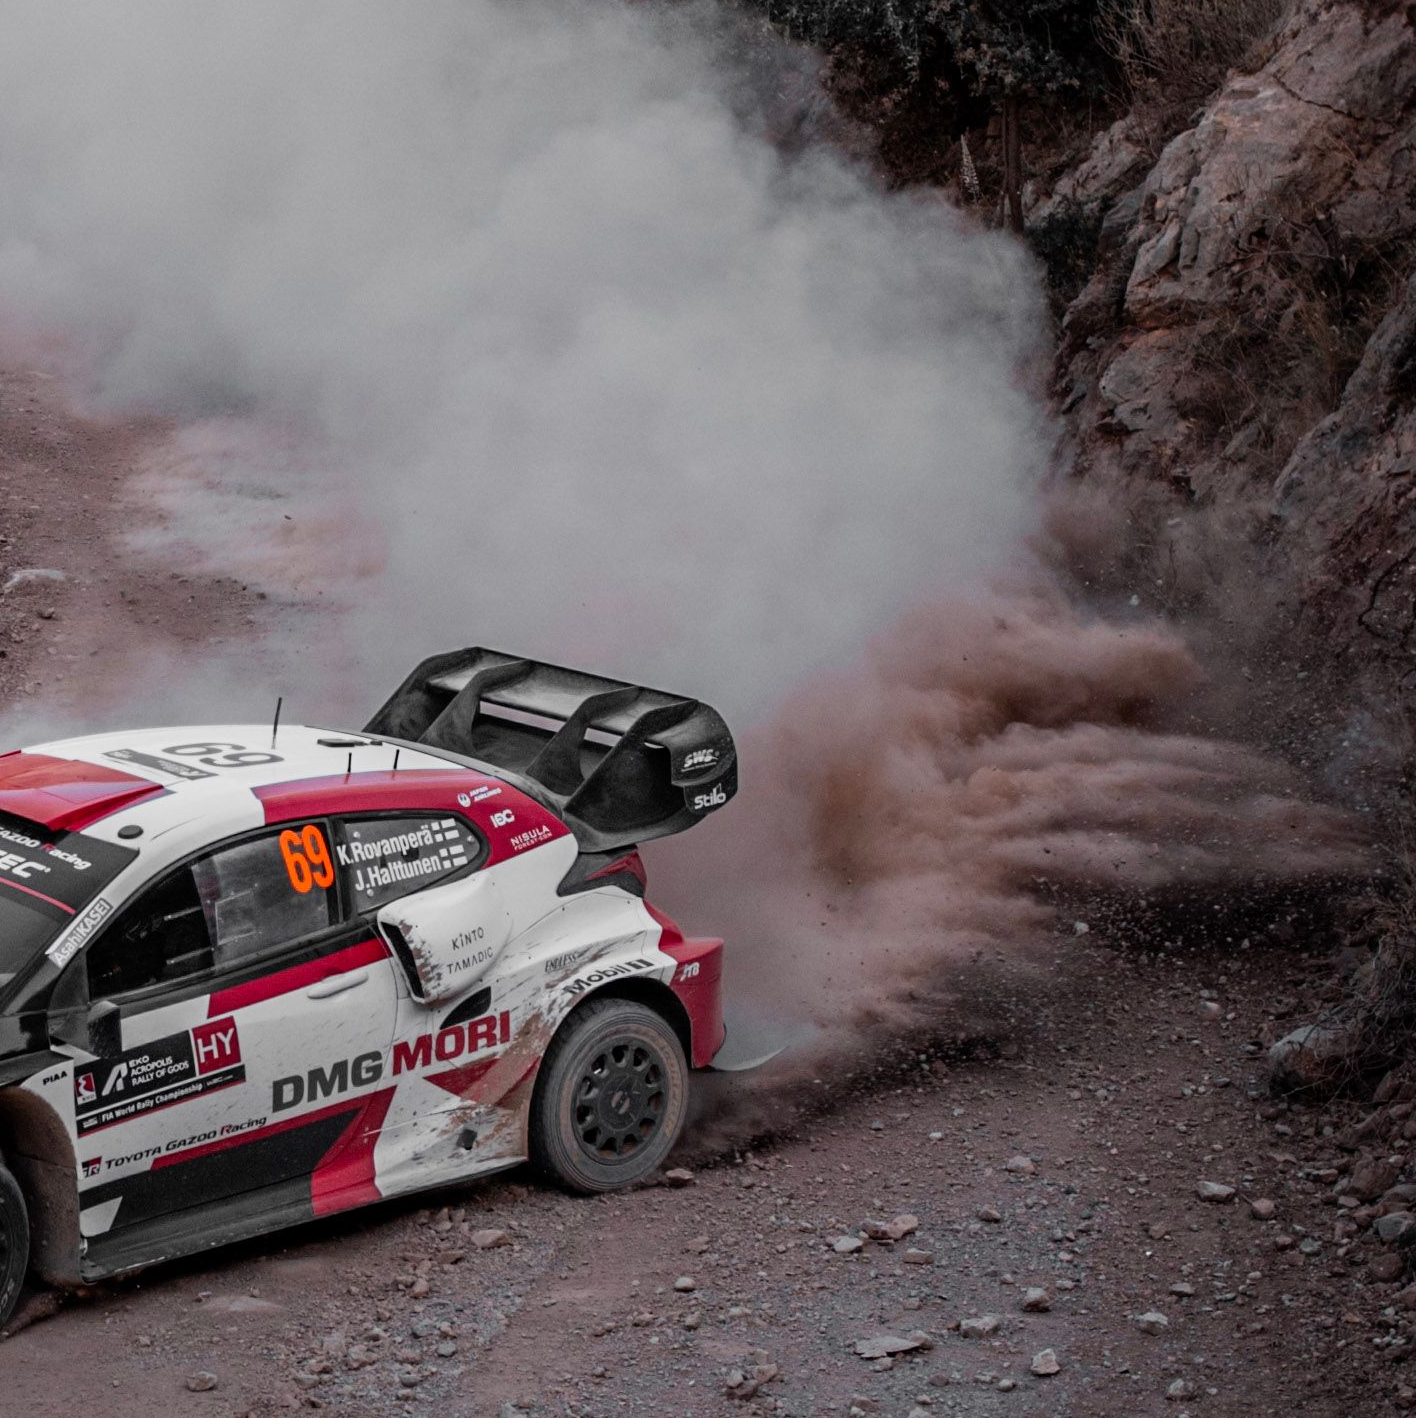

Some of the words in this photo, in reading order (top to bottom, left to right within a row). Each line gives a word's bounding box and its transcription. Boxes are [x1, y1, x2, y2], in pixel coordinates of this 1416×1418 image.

[162, 742, 285, 767] 69
[684, 749, 714, 768] SWS
[694, 784, 726, 809] Stilo
[337, 824, 433, 865] K.Rovanperä
[510, 825, 550, 846] NISULA
[41, 842, 92, 871] Racing
[279, 824, 334, 894] 69
[355, 855, 441, 891] J.Halttunen
[563, 963, 631, 996] Mobil
[198, 1028, 234, 1063] HY
[130, 1056, 173, 1077] ACROPOLIS
[272, 1050, 383, 1113] DMG
[392, 1010, 510, 1077] MORI
[42, 1070, 68, 1085] PIAA
[131, 1071, 158, 1087] RALLY
[101, 1111, 114, 1123] FIA
[155, 1082, 204, 1104] Championship
[105, 1147, 161, 1169] TOYOTA
[165, 1130, 217, 1152] GAZOO
[220, 1116, 267, 1136] Racing
